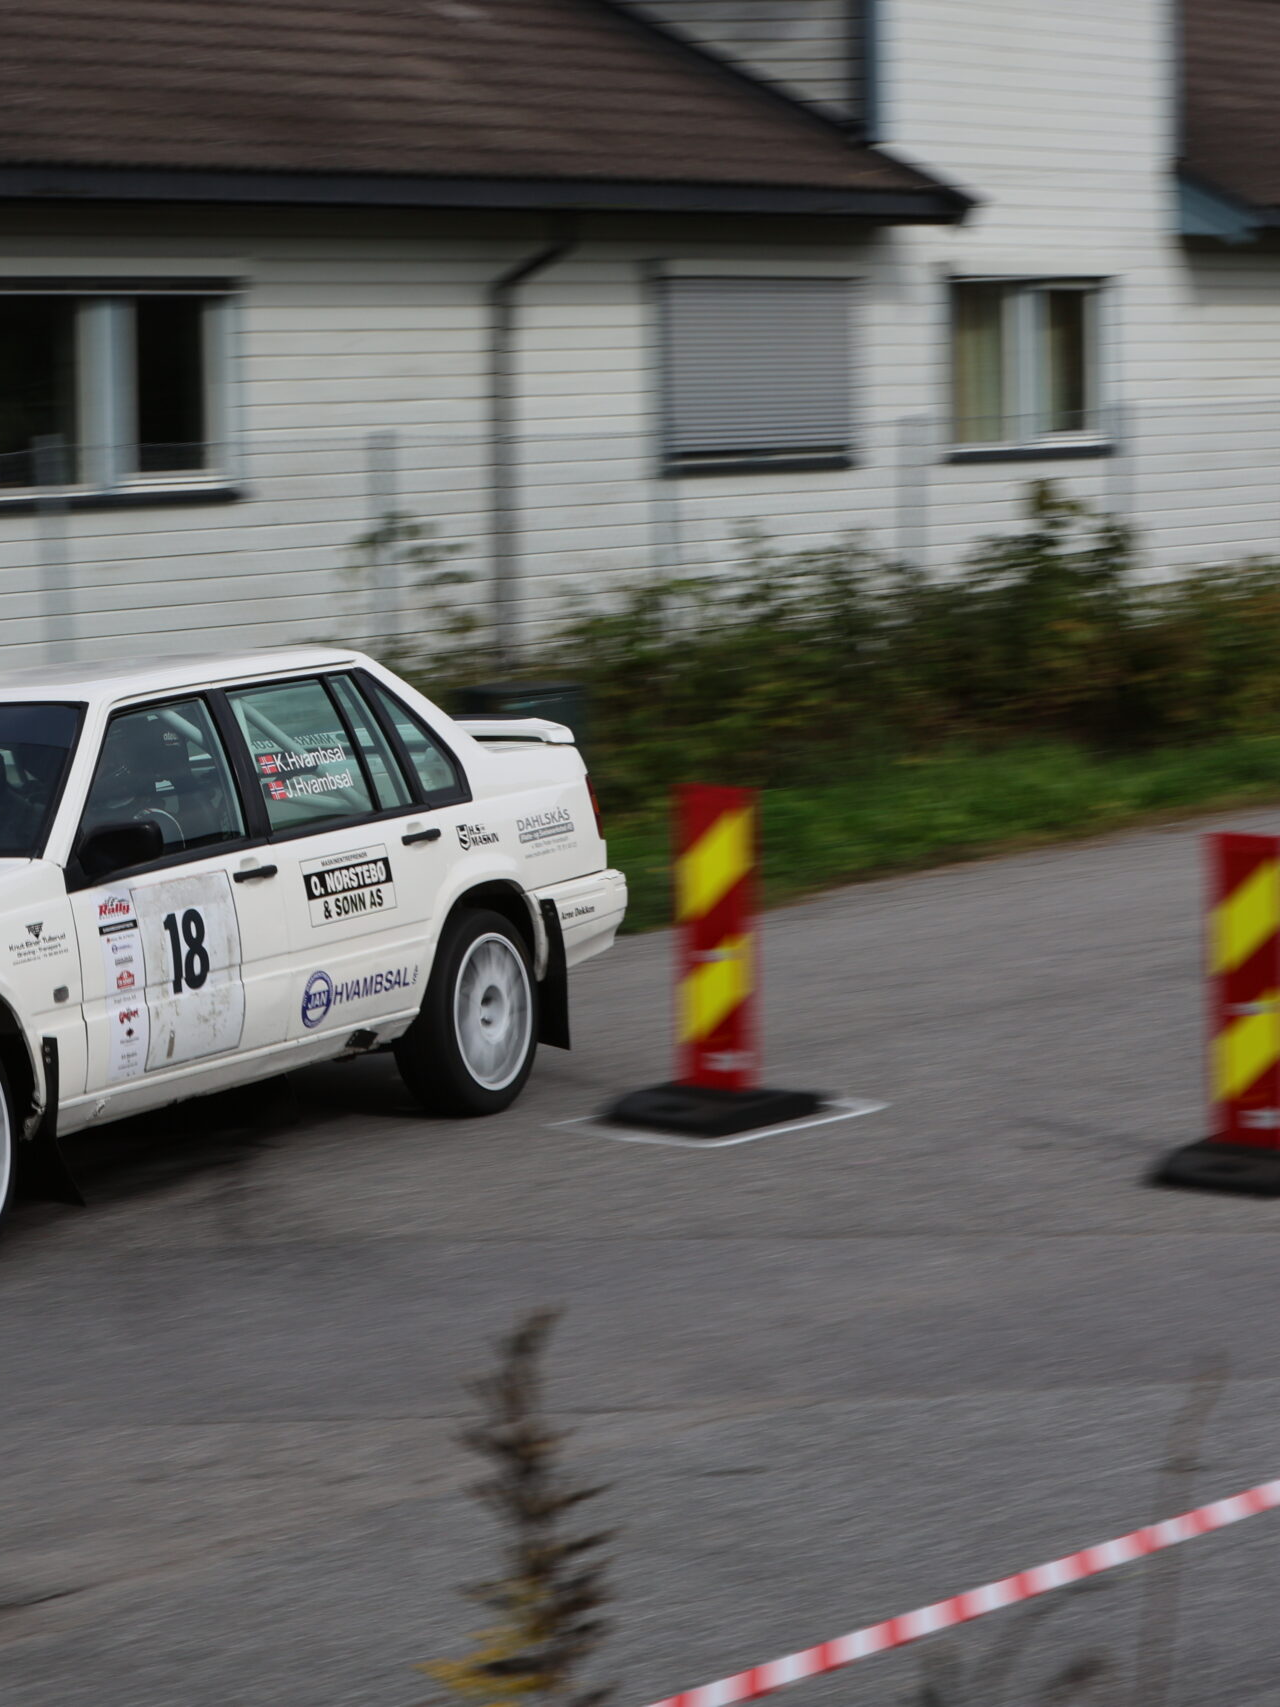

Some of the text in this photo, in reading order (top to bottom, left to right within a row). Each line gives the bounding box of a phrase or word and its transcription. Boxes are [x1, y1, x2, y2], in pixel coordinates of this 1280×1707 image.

[274, 744, 347, 773] K.Hvambsal
[286, 769, 354, 798] J.Hvambsal
[516, 806, 571, 831] DAHLSKÅS
[471, 832, 499, 847] MASKIN
[310, 860, 387, 896] O. NØRSTEBØ
[98, 903, 130, 916] Rally
[323, 900, 333, 920] &
[369, 888, 384, 909] AS
[163, 908, 210, 994] 18
[306, 990, 329, 1010] JAN
[333, 966, 410, 1006] HVAMBSAL
